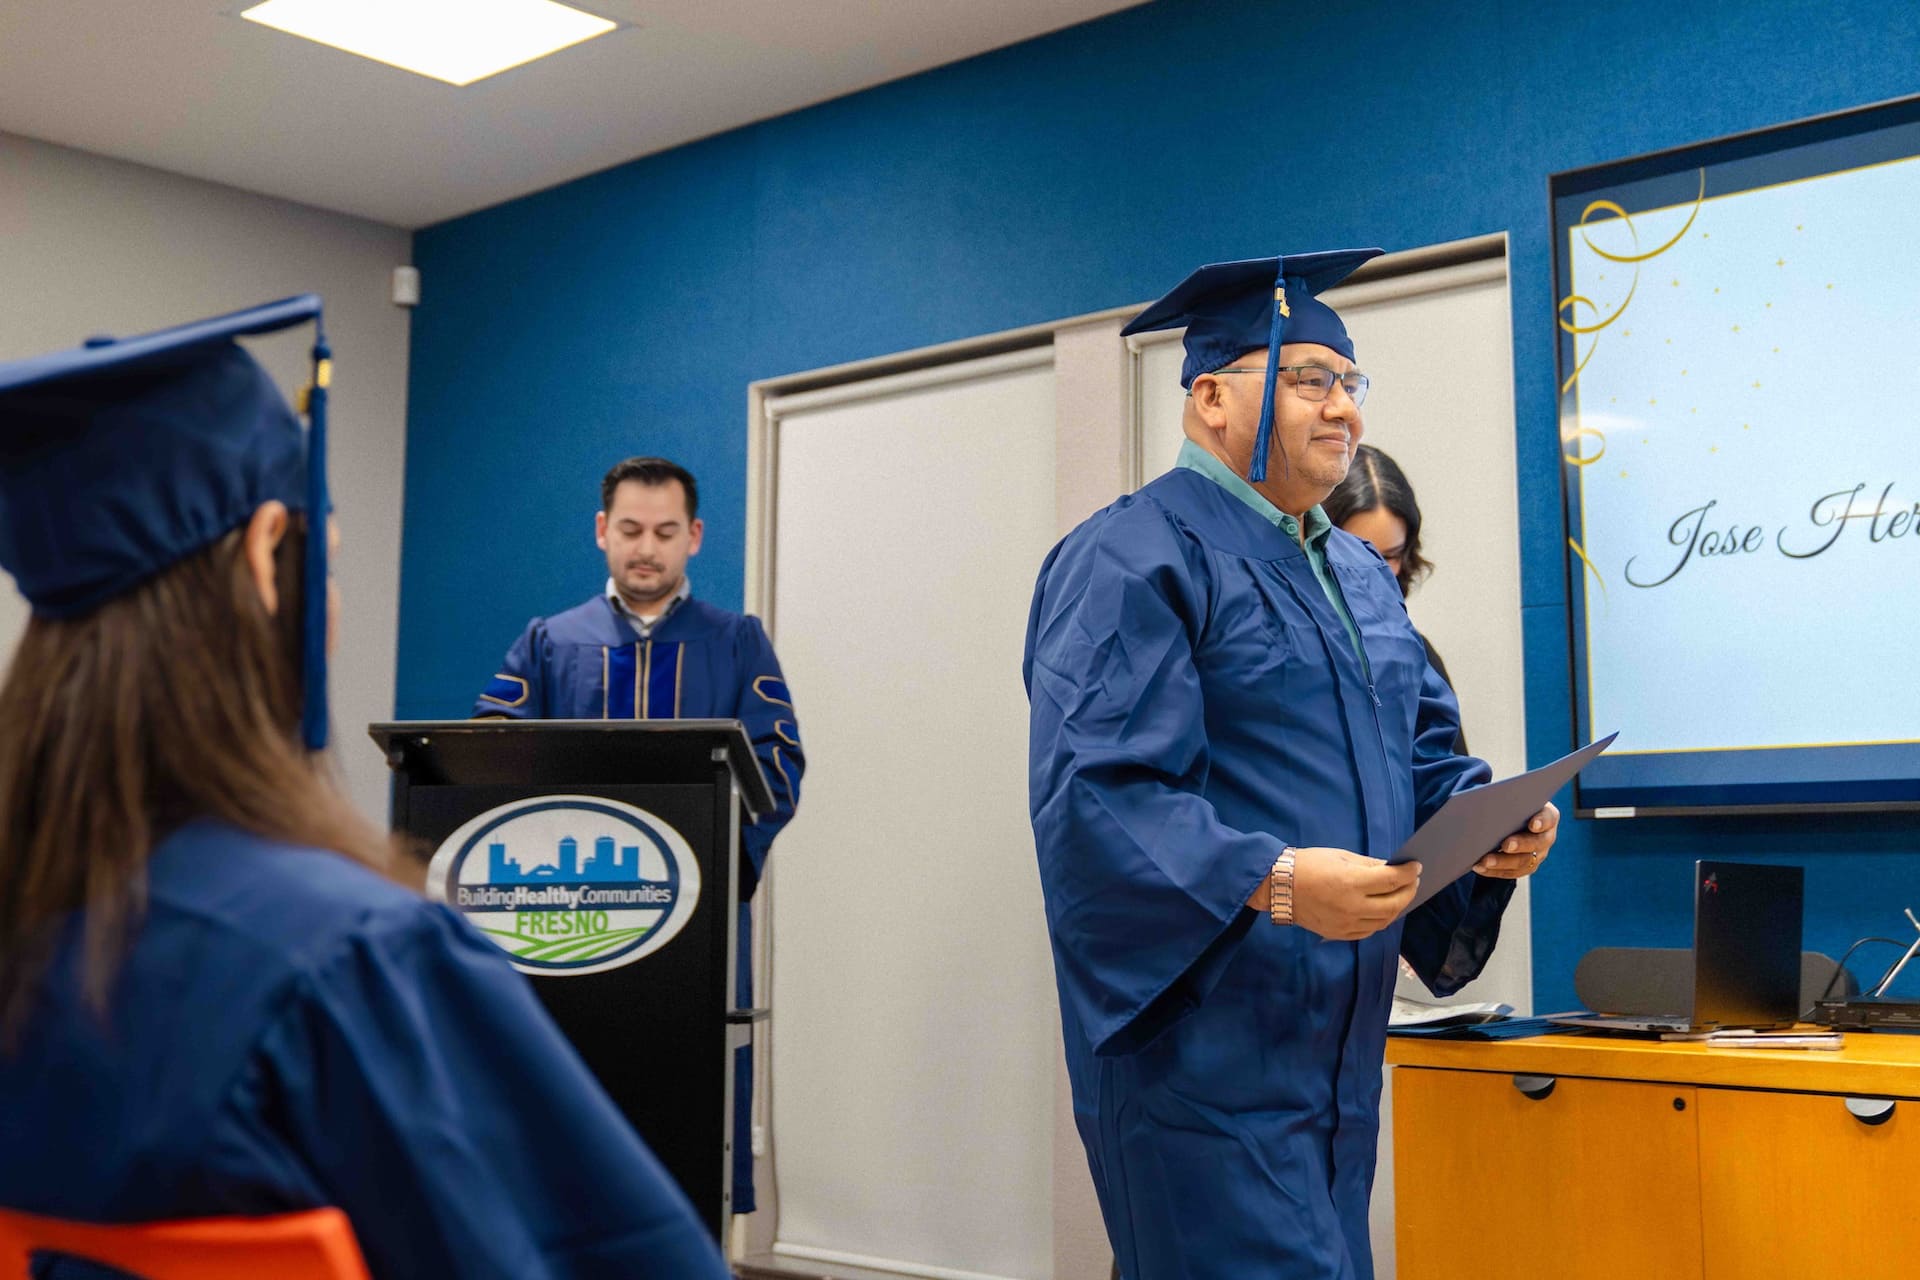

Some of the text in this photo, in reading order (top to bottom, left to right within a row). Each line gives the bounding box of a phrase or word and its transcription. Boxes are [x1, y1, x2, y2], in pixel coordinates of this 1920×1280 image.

[1624, 499, 1764, 589] Jose
[457, 884, 671, 911] BuildingHealthyCommunities
[516, 911, 608, 936] FRESNO
